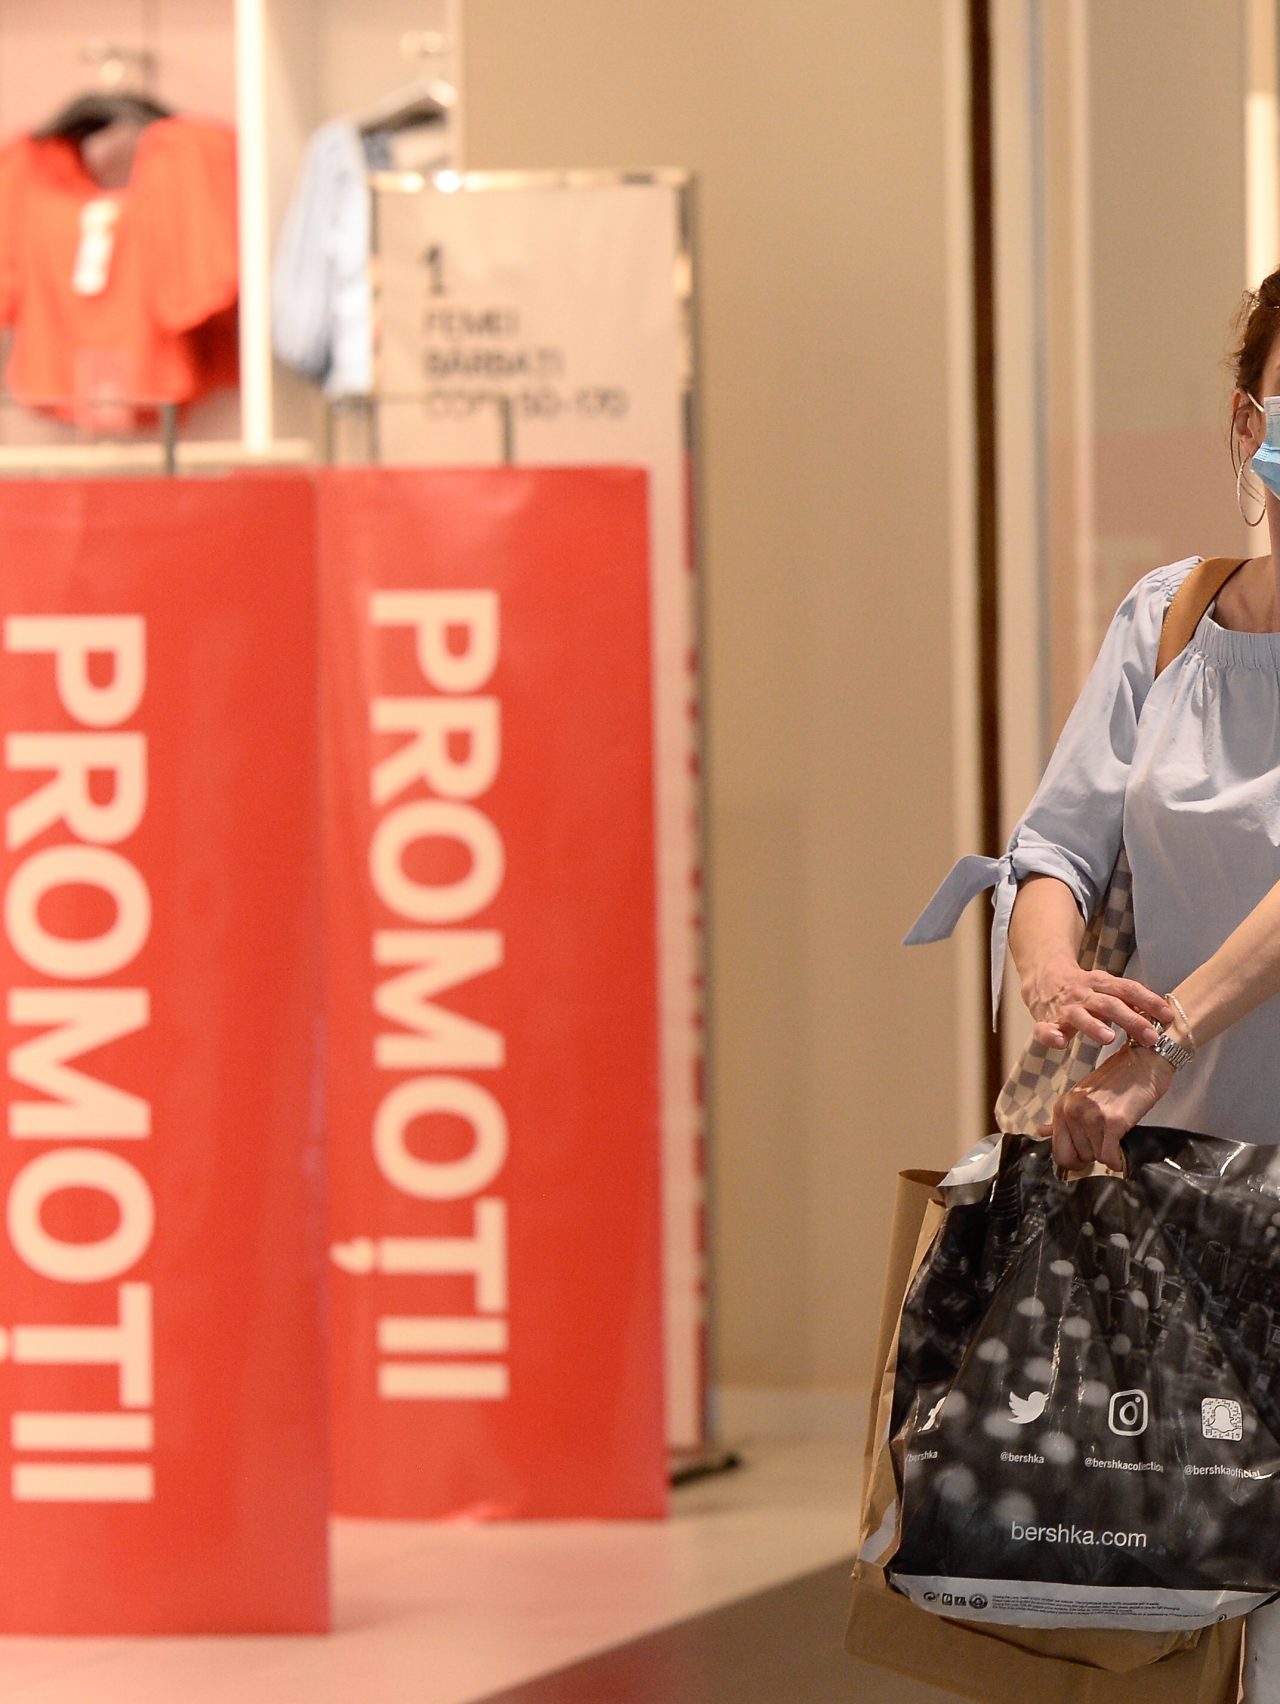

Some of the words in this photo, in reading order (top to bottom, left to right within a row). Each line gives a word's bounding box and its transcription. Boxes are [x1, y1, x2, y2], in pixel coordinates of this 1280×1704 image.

[421, 247, 445, 297] 1
[424, 311, 520, 335] FEMEI
[1000, 1451, 1045, 1464] @bershka
[1010, 1520, 1148, 1548] bershka.com
